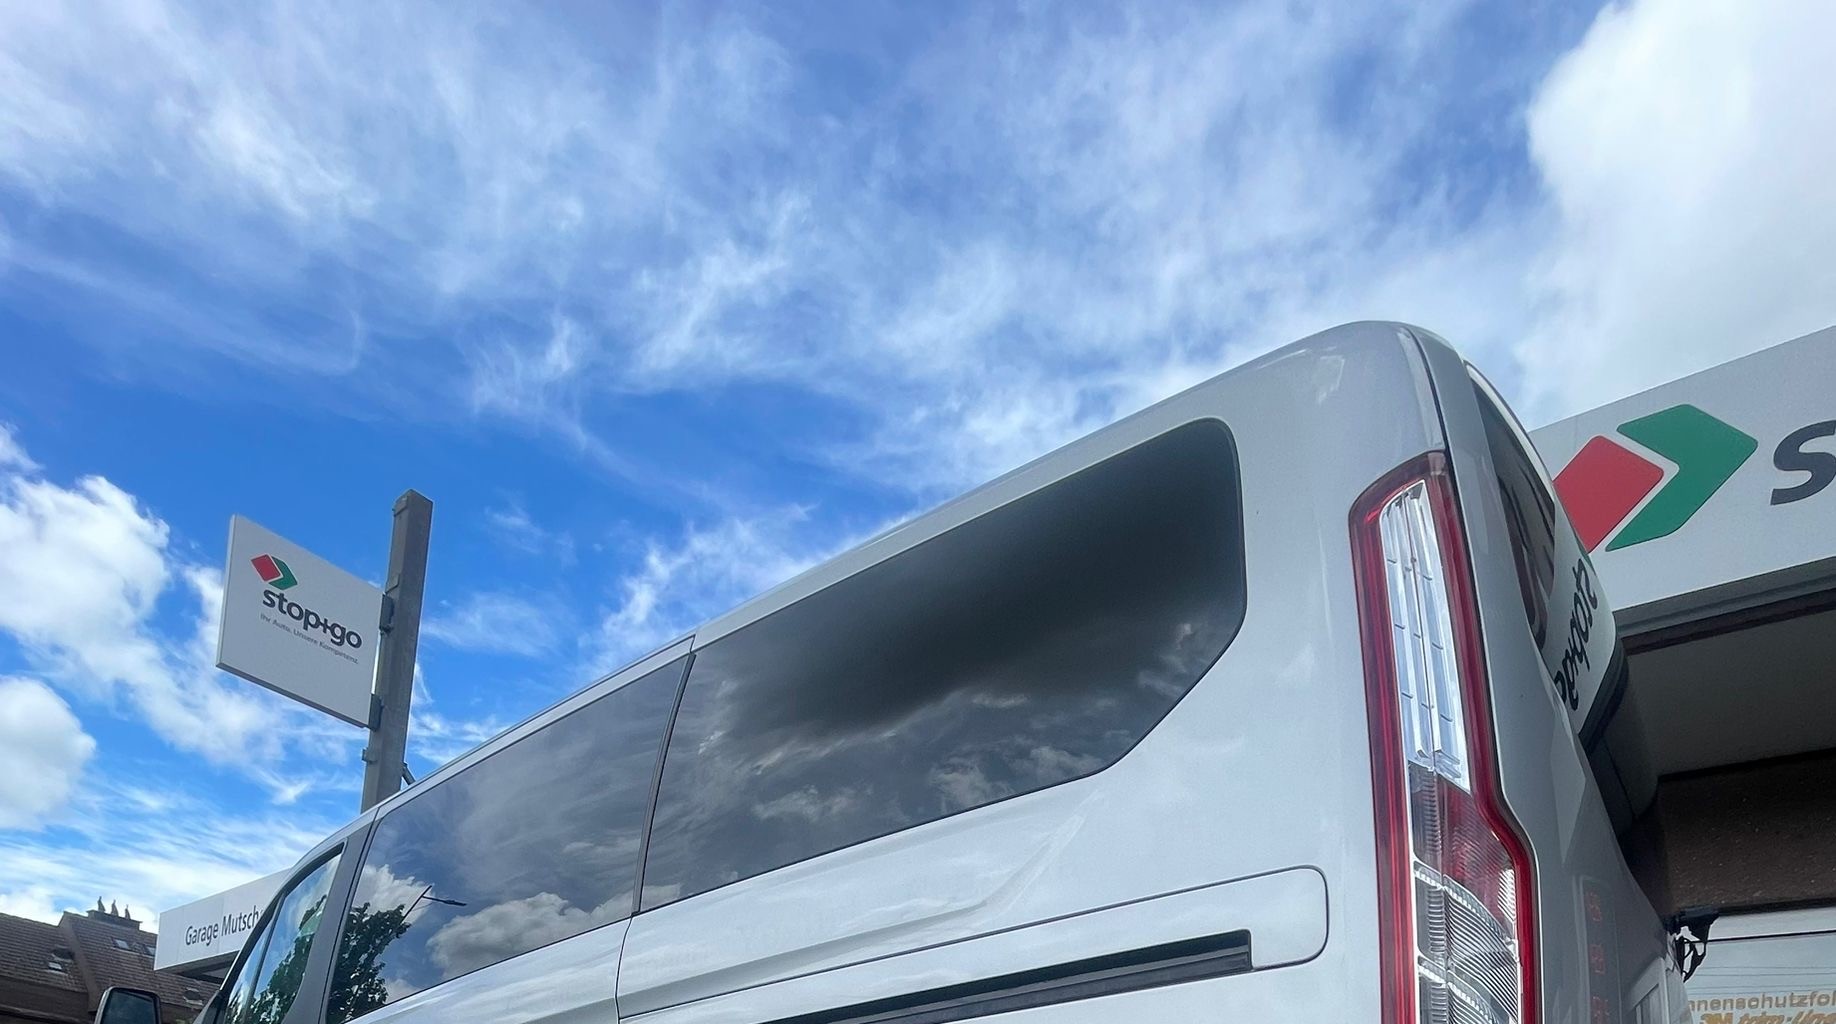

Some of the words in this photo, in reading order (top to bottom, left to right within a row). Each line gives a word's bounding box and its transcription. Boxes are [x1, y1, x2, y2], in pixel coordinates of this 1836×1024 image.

[262, 589, 362, 649] stop+go
[293, 629, 318, 645] Unsere
[185, 922, 219, 947] Garage
[221, 905, 264, 937] Mutsch
